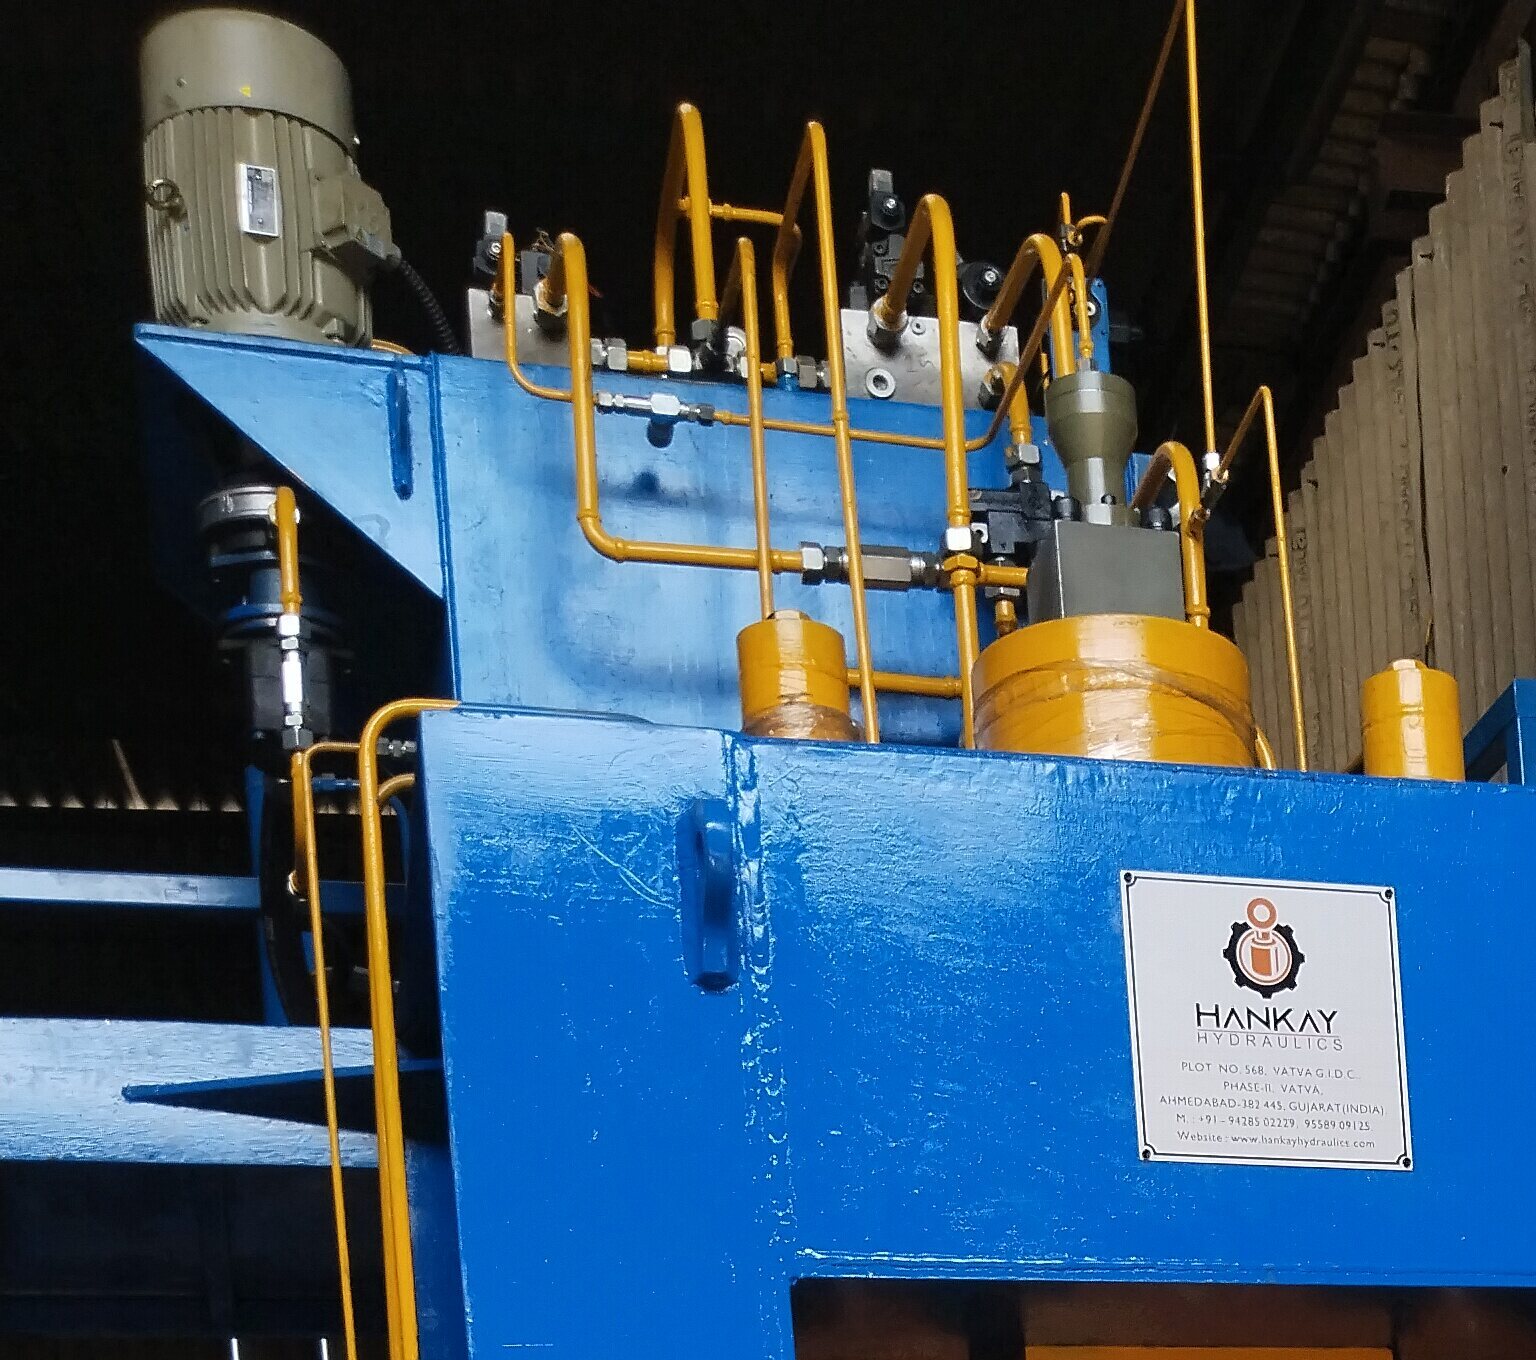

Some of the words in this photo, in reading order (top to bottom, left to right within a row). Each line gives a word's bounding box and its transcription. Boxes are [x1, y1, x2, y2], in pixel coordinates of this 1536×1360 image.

[1196, 1003, 1337, 1034] HANKAY
[1197, 1032, 1343, 1051] HYDRAULICS
[1181, 1061, 1212, 1072] PLOT
[1273, 1066, 1313, 1077] VATVA
